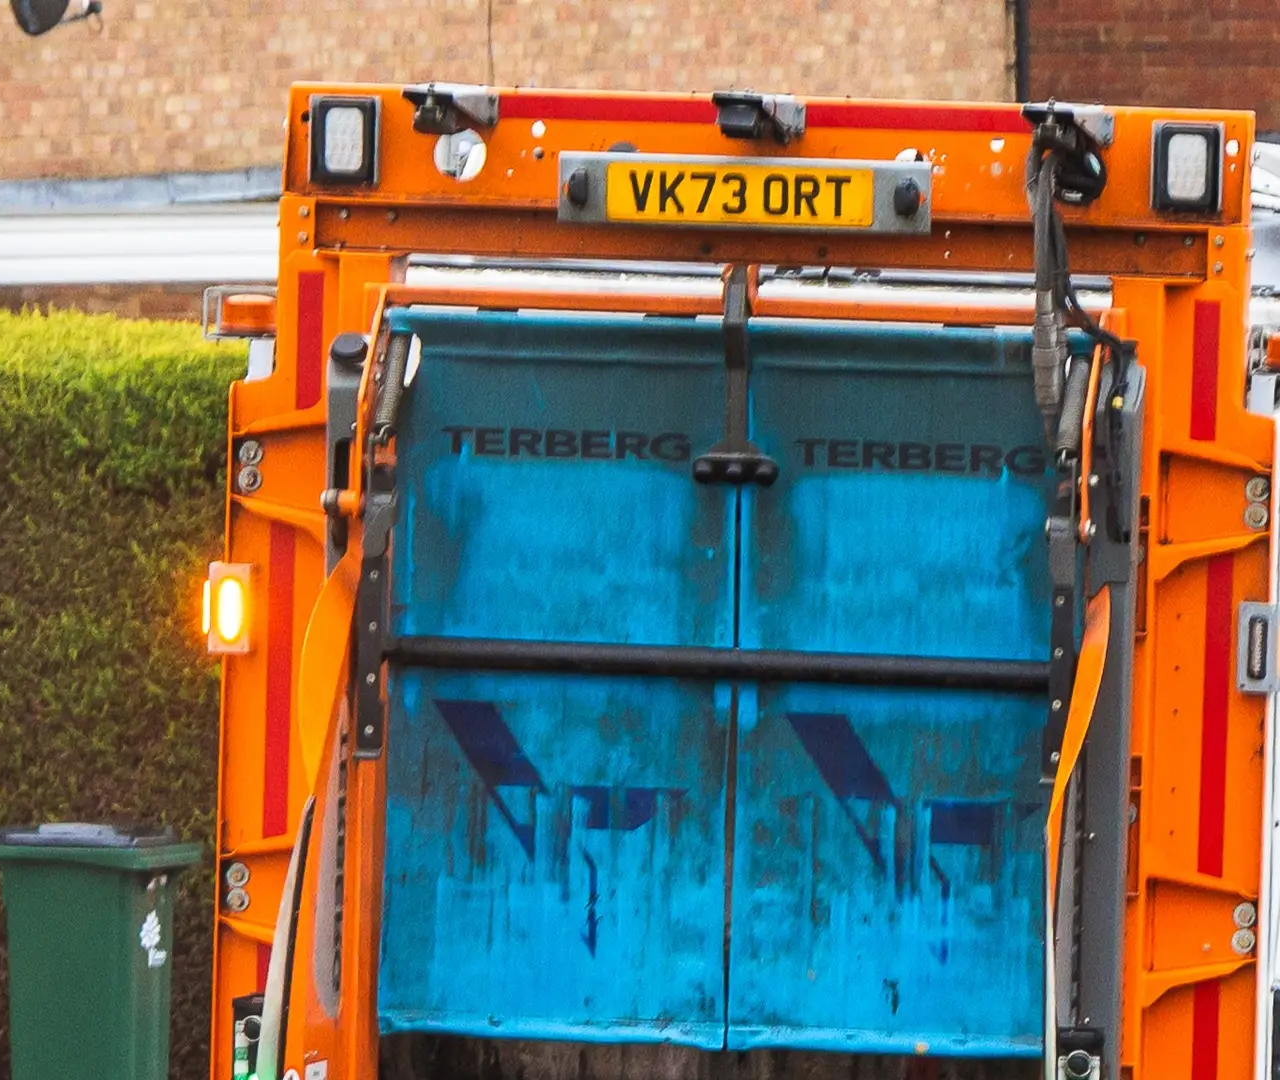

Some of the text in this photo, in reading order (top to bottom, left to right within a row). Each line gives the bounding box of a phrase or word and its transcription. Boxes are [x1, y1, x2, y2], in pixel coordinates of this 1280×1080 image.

[628, 169, 852, 217] VK73 ORT
[441, 424, 692, 462] TERBERG
[795, 437, 1047, 475] TERBERG
